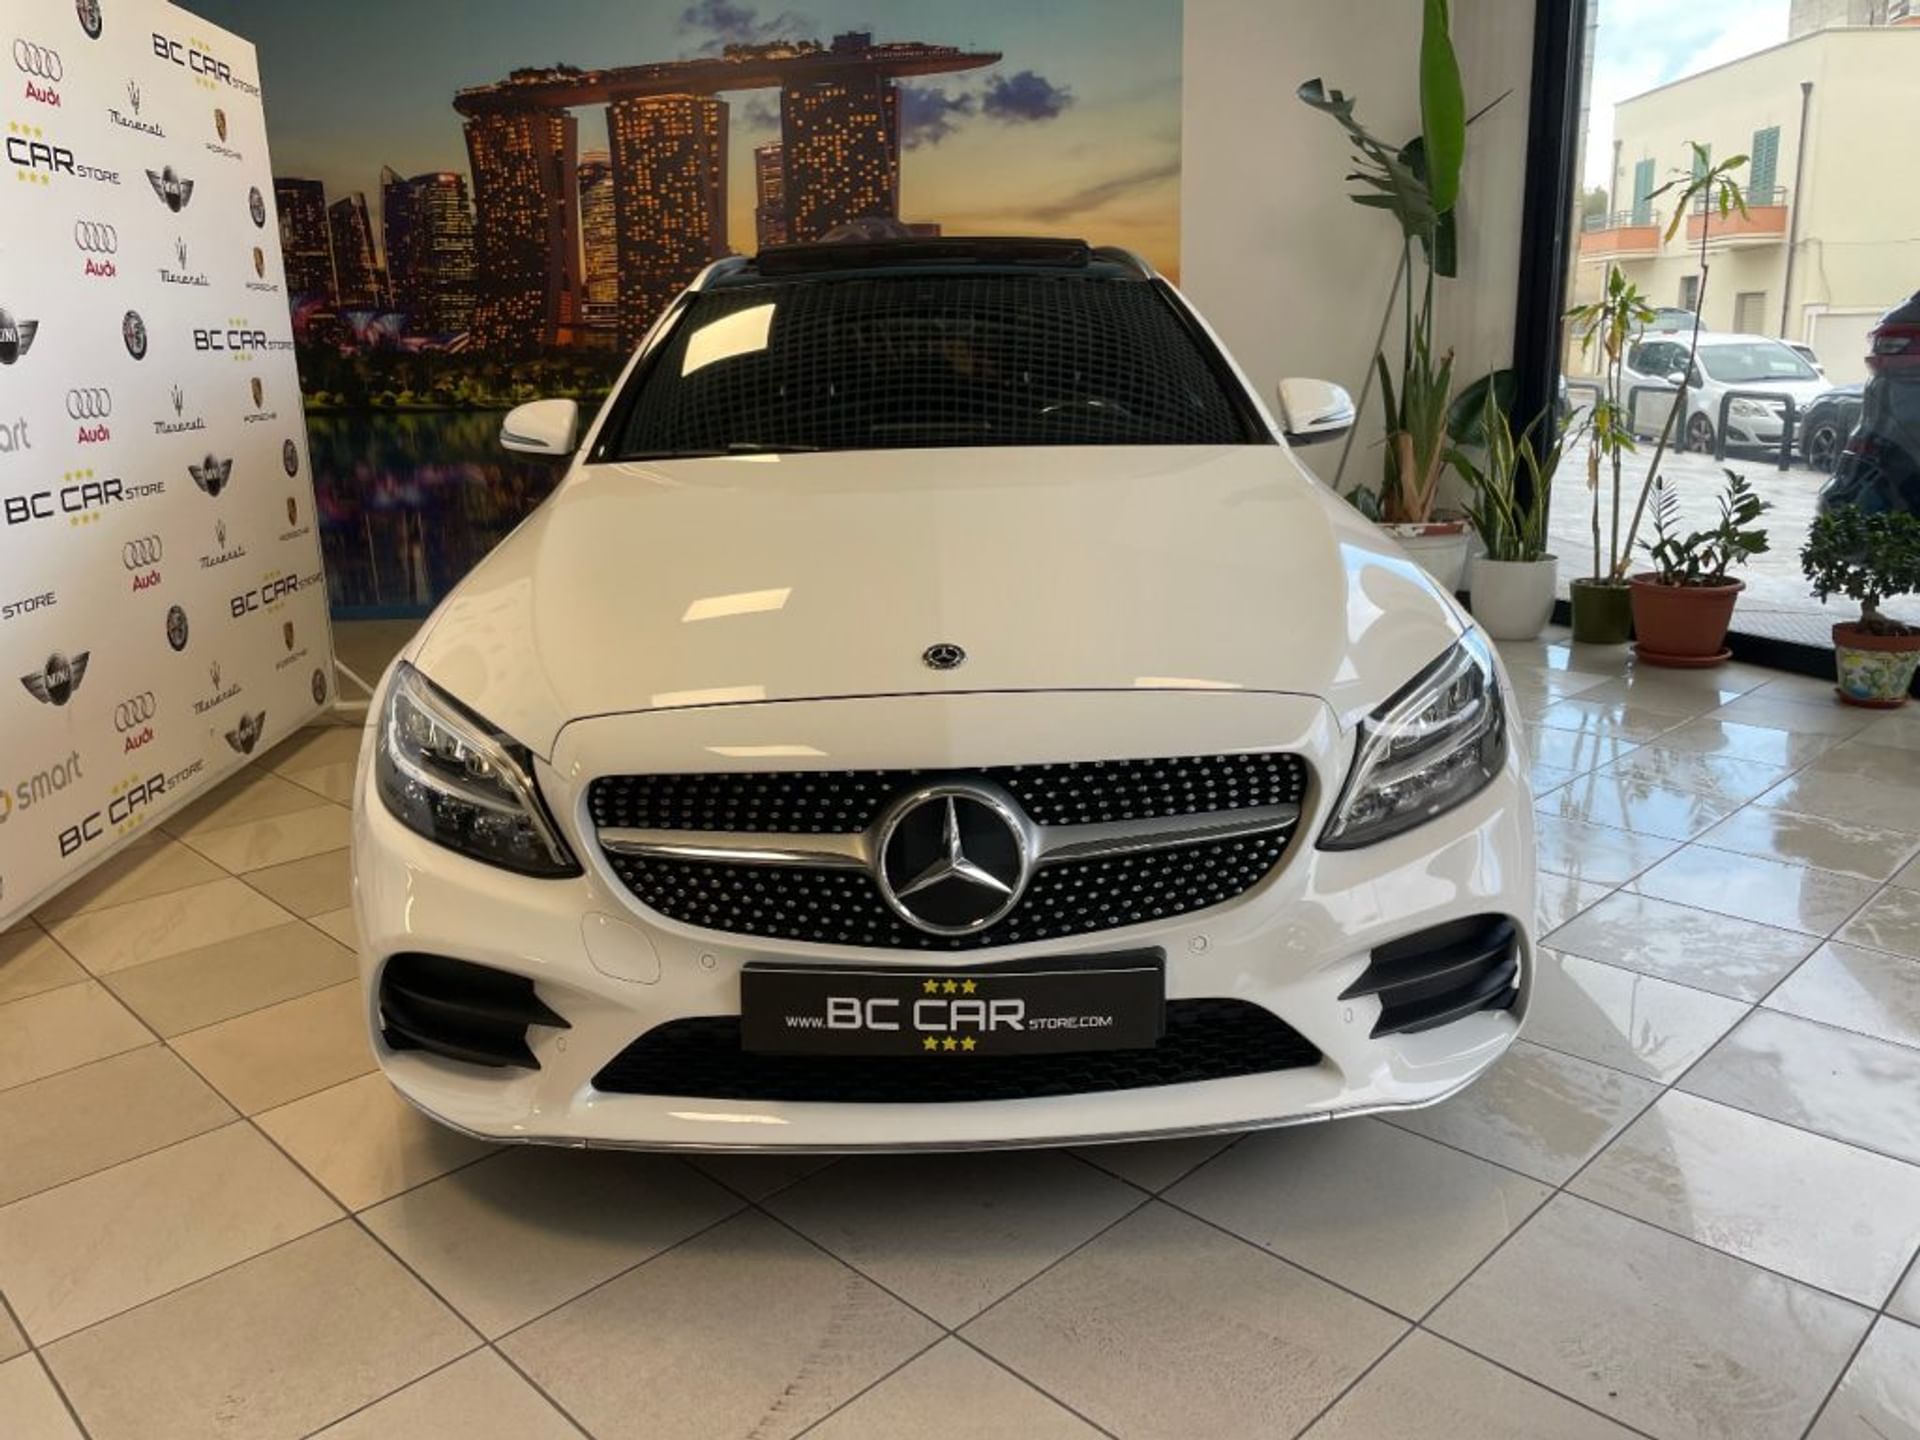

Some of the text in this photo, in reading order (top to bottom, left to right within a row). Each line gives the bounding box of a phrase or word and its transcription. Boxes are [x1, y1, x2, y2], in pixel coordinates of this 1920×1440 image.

[152, 34, 185, 65] BC
[189, 51, 232, 86] CAR
[25, 81, 61, 107] Audi
[6, 137, 121, 185] CAR STORE
[84, 258, 116, 277] Audi
[193, 330, 224, 350] BC
[228, 331, 267, 350] CAR
[77, 425, 110, 444] Audi
[5, 479, 166, 525] BC CAR STORE
[132, 570, 161, 592] Audi
[231, 591, 259, 618] BC
[262, 574, 299, 604] CAR
[2, 592, 57, 619] STORE
[124, 726, 154, 755] Audi
[15, 750, 83, 811] smart
[58, 759, 204, 858] BC CAR STORE
[913, 1000, 1025, 1032] CAR
[1029, 1015, 1112, 1031] STORE.COM
